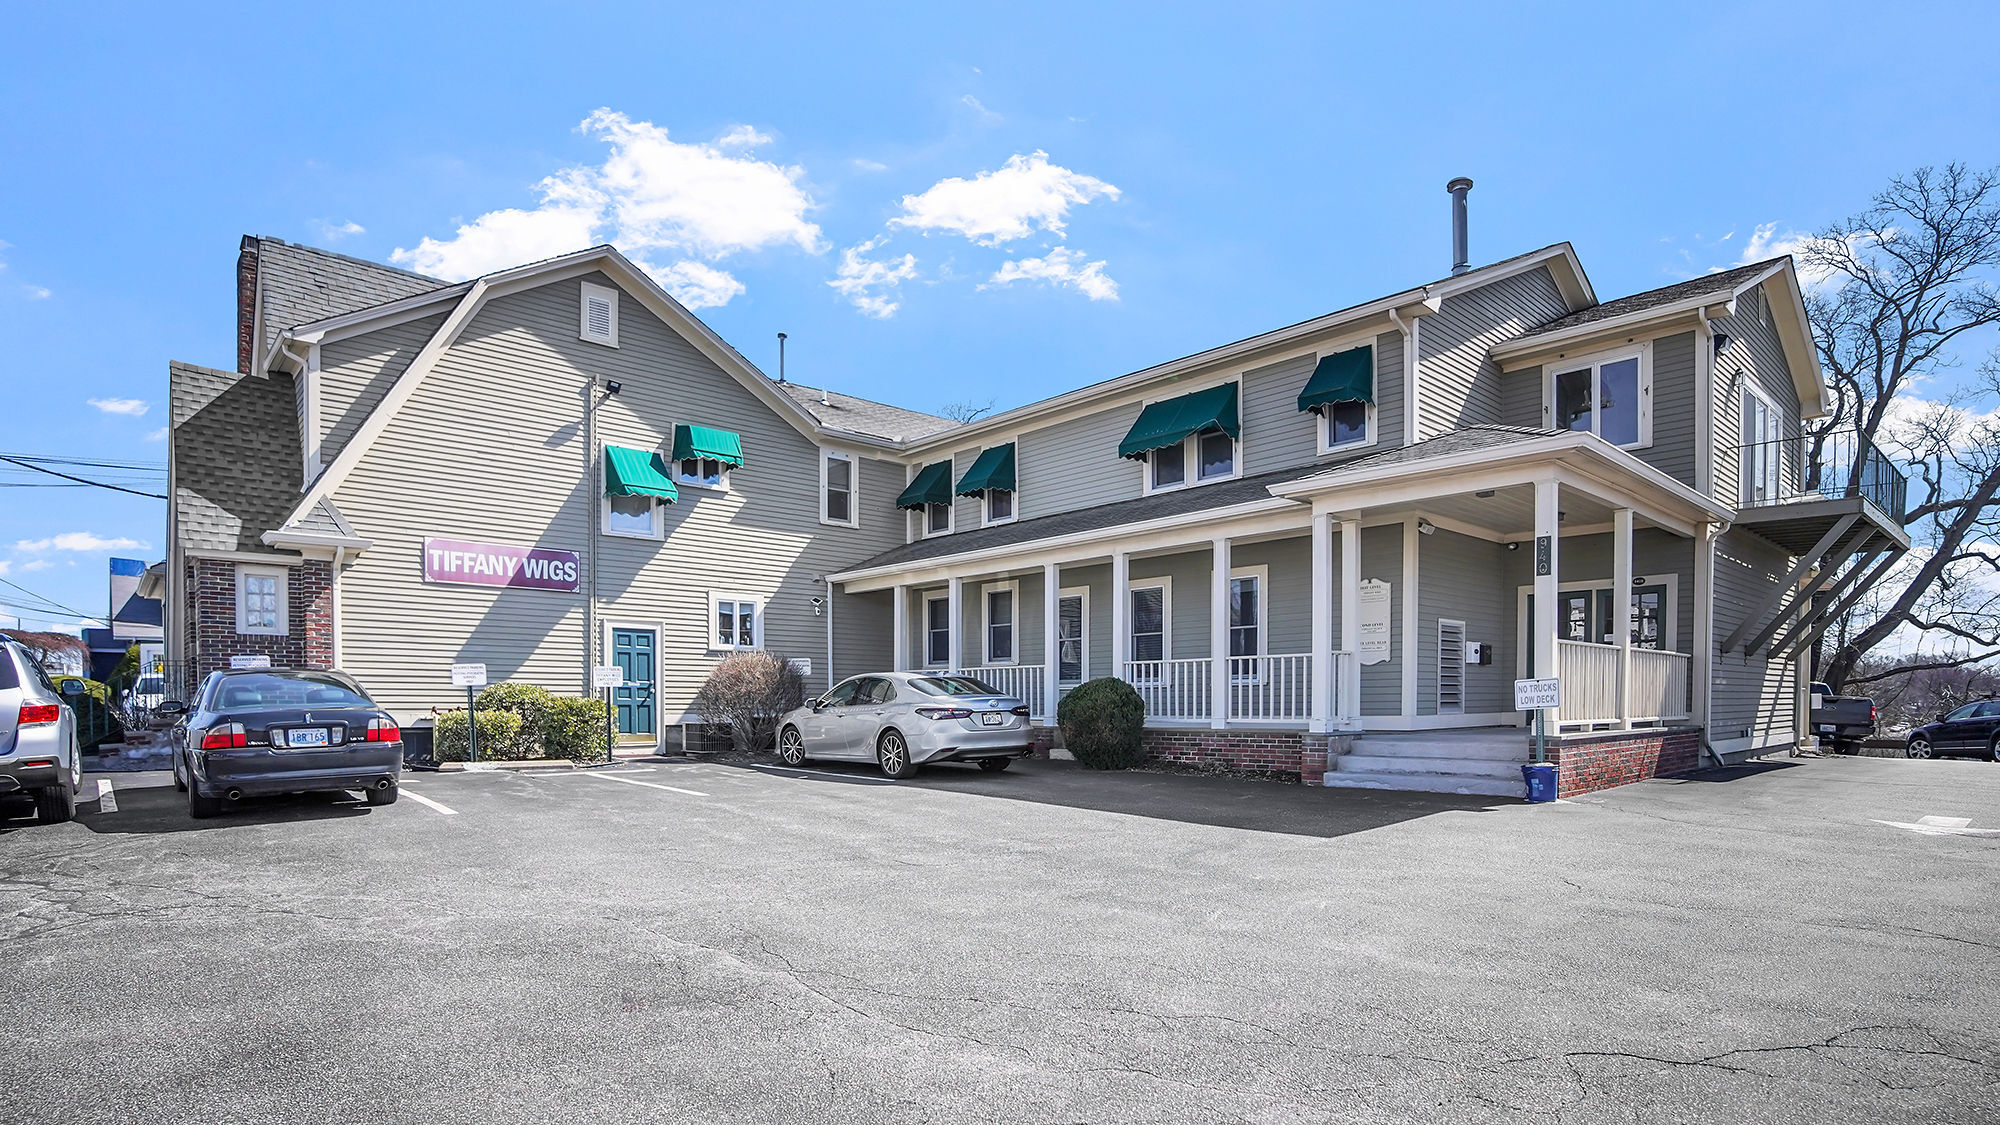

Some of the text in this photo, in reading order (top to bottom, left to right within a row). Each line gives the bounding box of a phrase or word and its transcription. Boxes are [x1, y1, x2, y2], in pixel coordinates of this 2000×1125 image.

[428, 549, 577, 582] TIFFANY WIGS
[1539, 537, 1548, 574] 940
[1518, 682, 1557, 694] NO TRUCKS
[1521, 694, 1556, 705] LOW DECK
